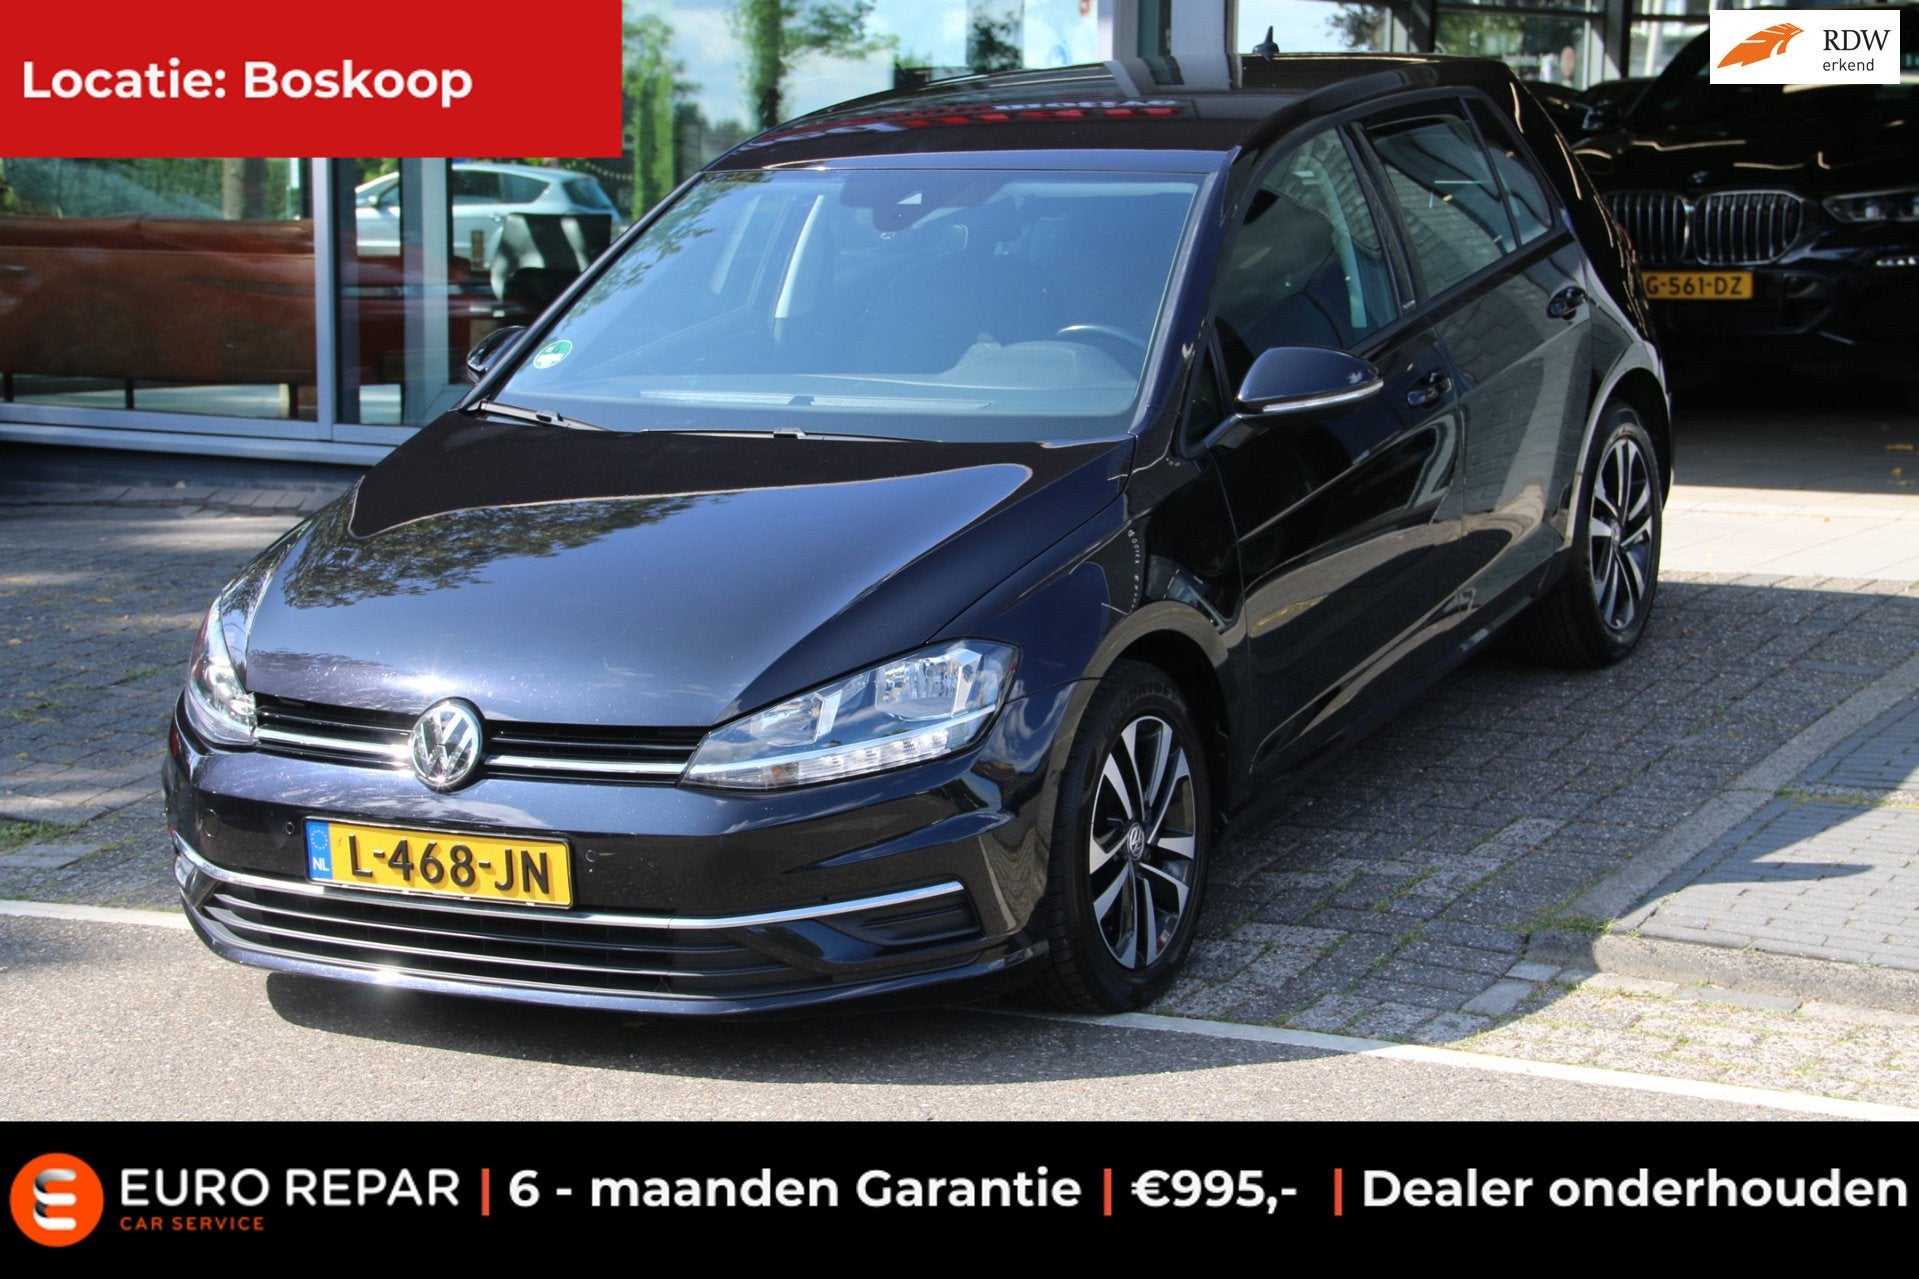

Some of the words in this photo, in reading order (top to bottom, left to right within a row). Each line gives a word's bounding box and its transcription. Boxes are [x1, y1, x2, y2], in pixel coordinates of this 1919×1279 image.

[1646, 276, 1742, 296] G-561-DZ
[312, 856, 330, 872] NL
[348, 833, 549, 894] L-468-JN
